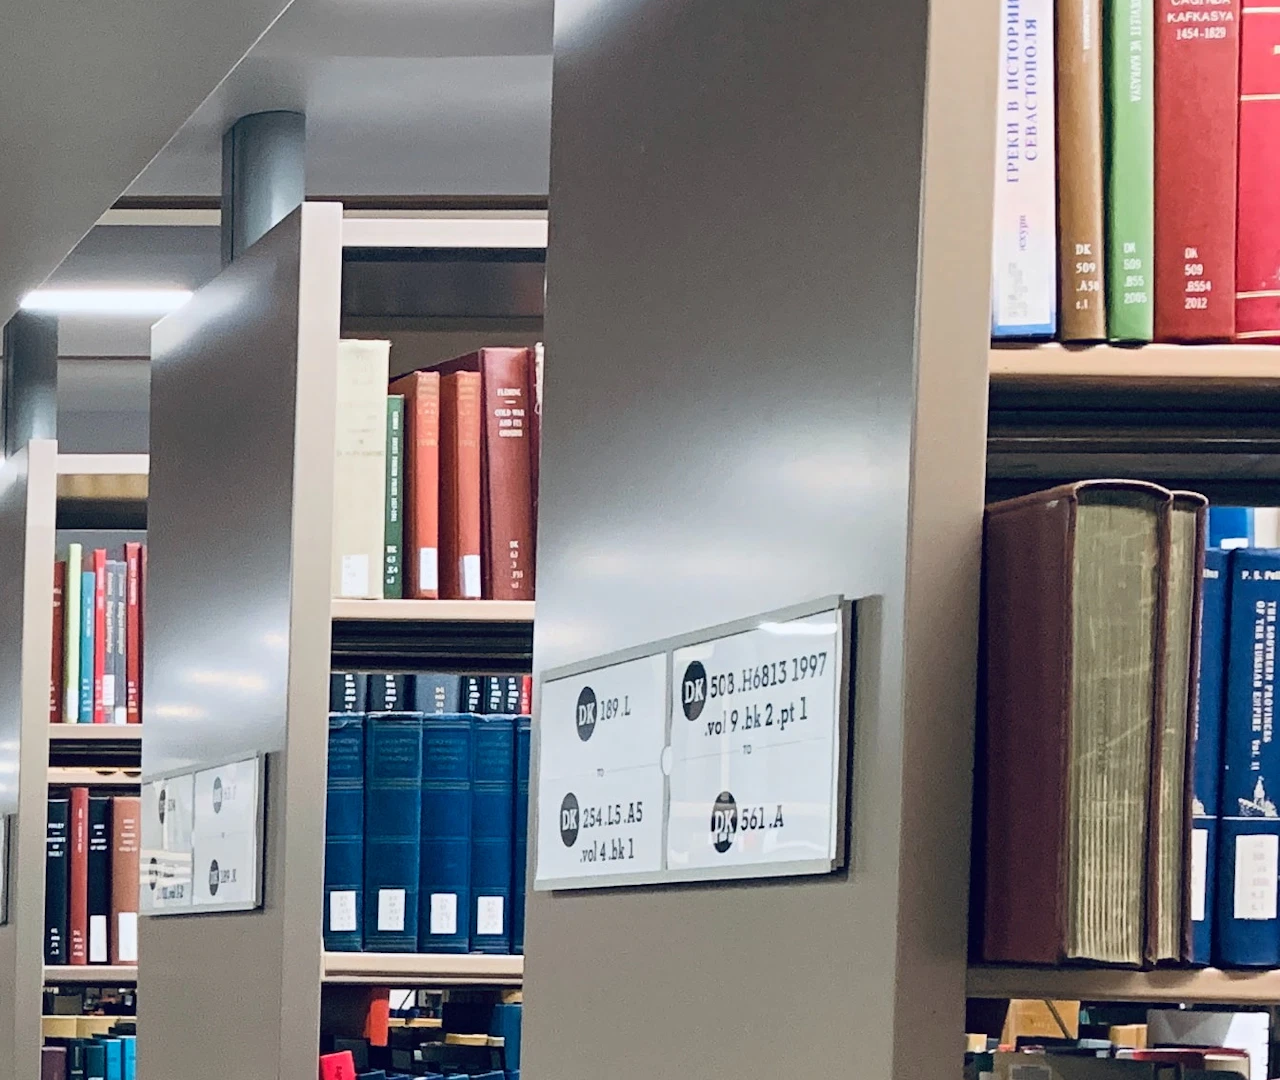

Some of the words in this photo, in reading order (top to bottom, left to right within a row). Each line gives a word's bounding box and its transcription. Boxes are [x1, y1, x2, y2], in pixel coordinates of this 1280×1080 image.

[1167, 11, 1234, 23] KAFKASYA
[1025, 19, 1037, 161] СЕВАСТОПОЛЯ
[1007, 122, 1019, 183] ГРЕКИ
[1185, 298, 1208, 310] 2012
[1256, 601, 1265, 614] OF
[1265, 625, 1275, 681] SOUTHERN
[684, 680, 707, 703] DK
[711, 673, 734, 698] 508
[739, 661, 787, 693] .H6813
[792, 652, 827, 682] 1997
[578, 705, 597, 719] DK
[600, 699, 619, 721] 189
[621, 696, 631, 717] .L
[704, 713, 726, 736] .vol
[731, 709, 738, 732] 9
[742, 704, 761, 731] .bk
[765, 704, 773, 726] 2
[777, 704, 794, 731] .pt
[1263, 684, 1274, 743] PROVINCES
[743, 745, 752, 754] TO
[562, 811, 578, 830] DK
[583, 808, 603, 829] 254
[740, 808, 765, 831] 561
[769, 805, 784, 829] .A
[580, 843, 597, 863] .vol
[600, 841, 606, 861] 4
[608, 839, 625, 860] .bk
